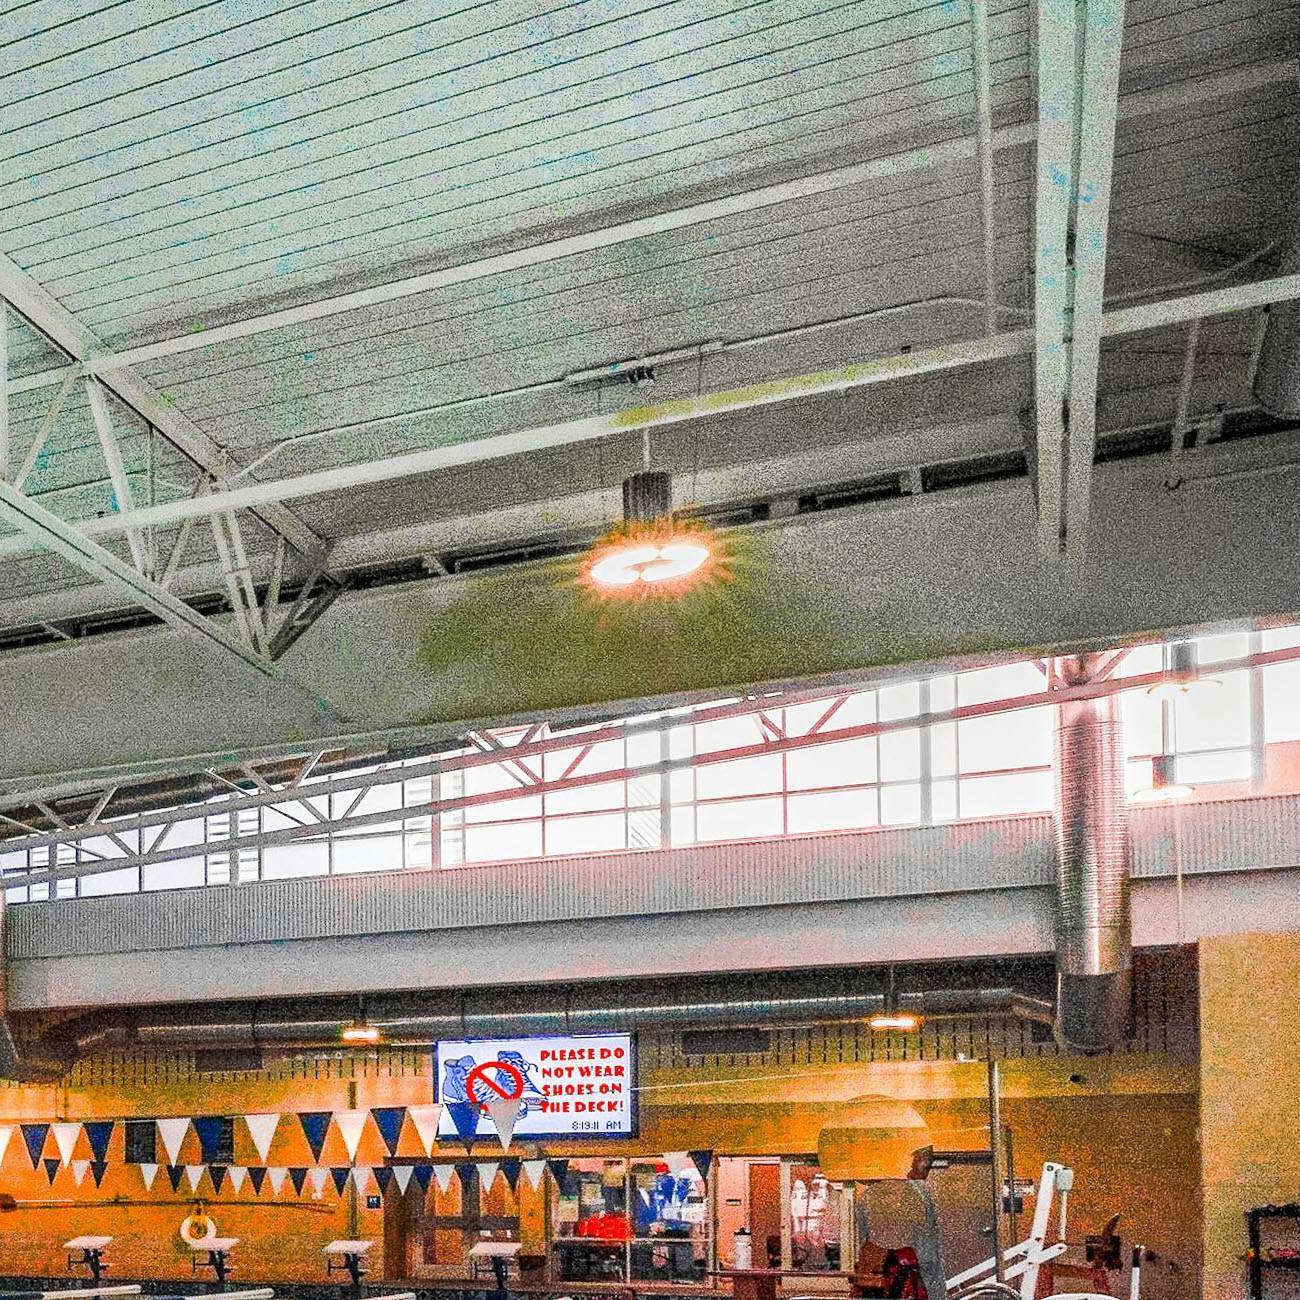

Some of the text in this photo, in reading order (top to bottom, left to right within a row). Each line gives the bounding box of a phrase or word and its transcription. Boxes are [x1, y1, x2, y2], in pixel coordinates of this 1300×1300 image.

[540, 1048, 624, 1061] PLEASE DO
[542, 1066, 624, 1078] NOT WEAR
[542, 1083, 622, 1096] SHOES ON
[541, 1101, 623, 1113] THE DECK!
[606, 1121, 622, 1130] AM
